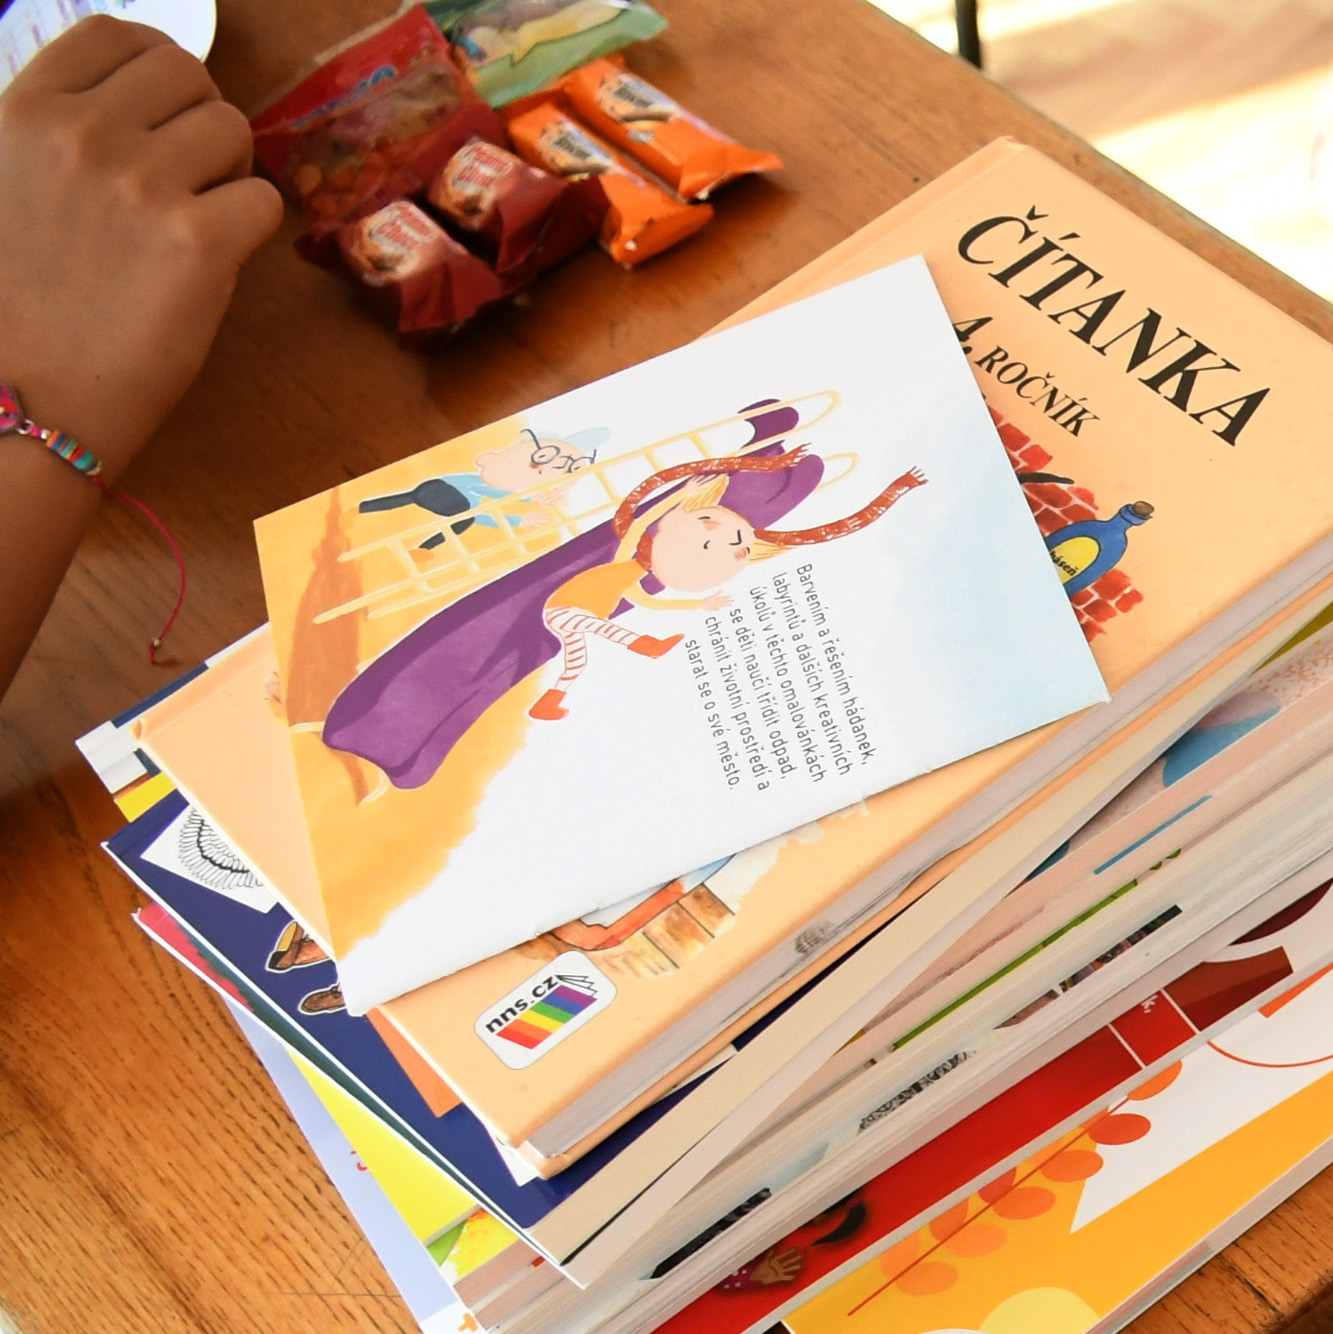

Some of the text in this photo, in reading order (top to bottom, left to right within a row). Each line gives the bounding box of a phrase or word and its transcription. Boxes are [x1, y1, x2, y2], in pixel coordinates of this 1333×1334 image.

[957, 204, 1271, 447] ČÍTANKA
[974, 345, 1100, 437] ROČNÍK
[684, 638, 742, 790] starat se o své město.
[704, 615, 770, 790] chránit životní prostředí a
[729, 608, 798, 779] se děti naučí třídit odpad,
[748, 585, 828, 782] úkolů v těchto omalovánkách
[770, 572, 852, 775] labyrintů a dalších kreativních
[795, 564, 876, 764] Barvením a řešením hádanek,
[485, 976, 558, 1033] nns.cz
